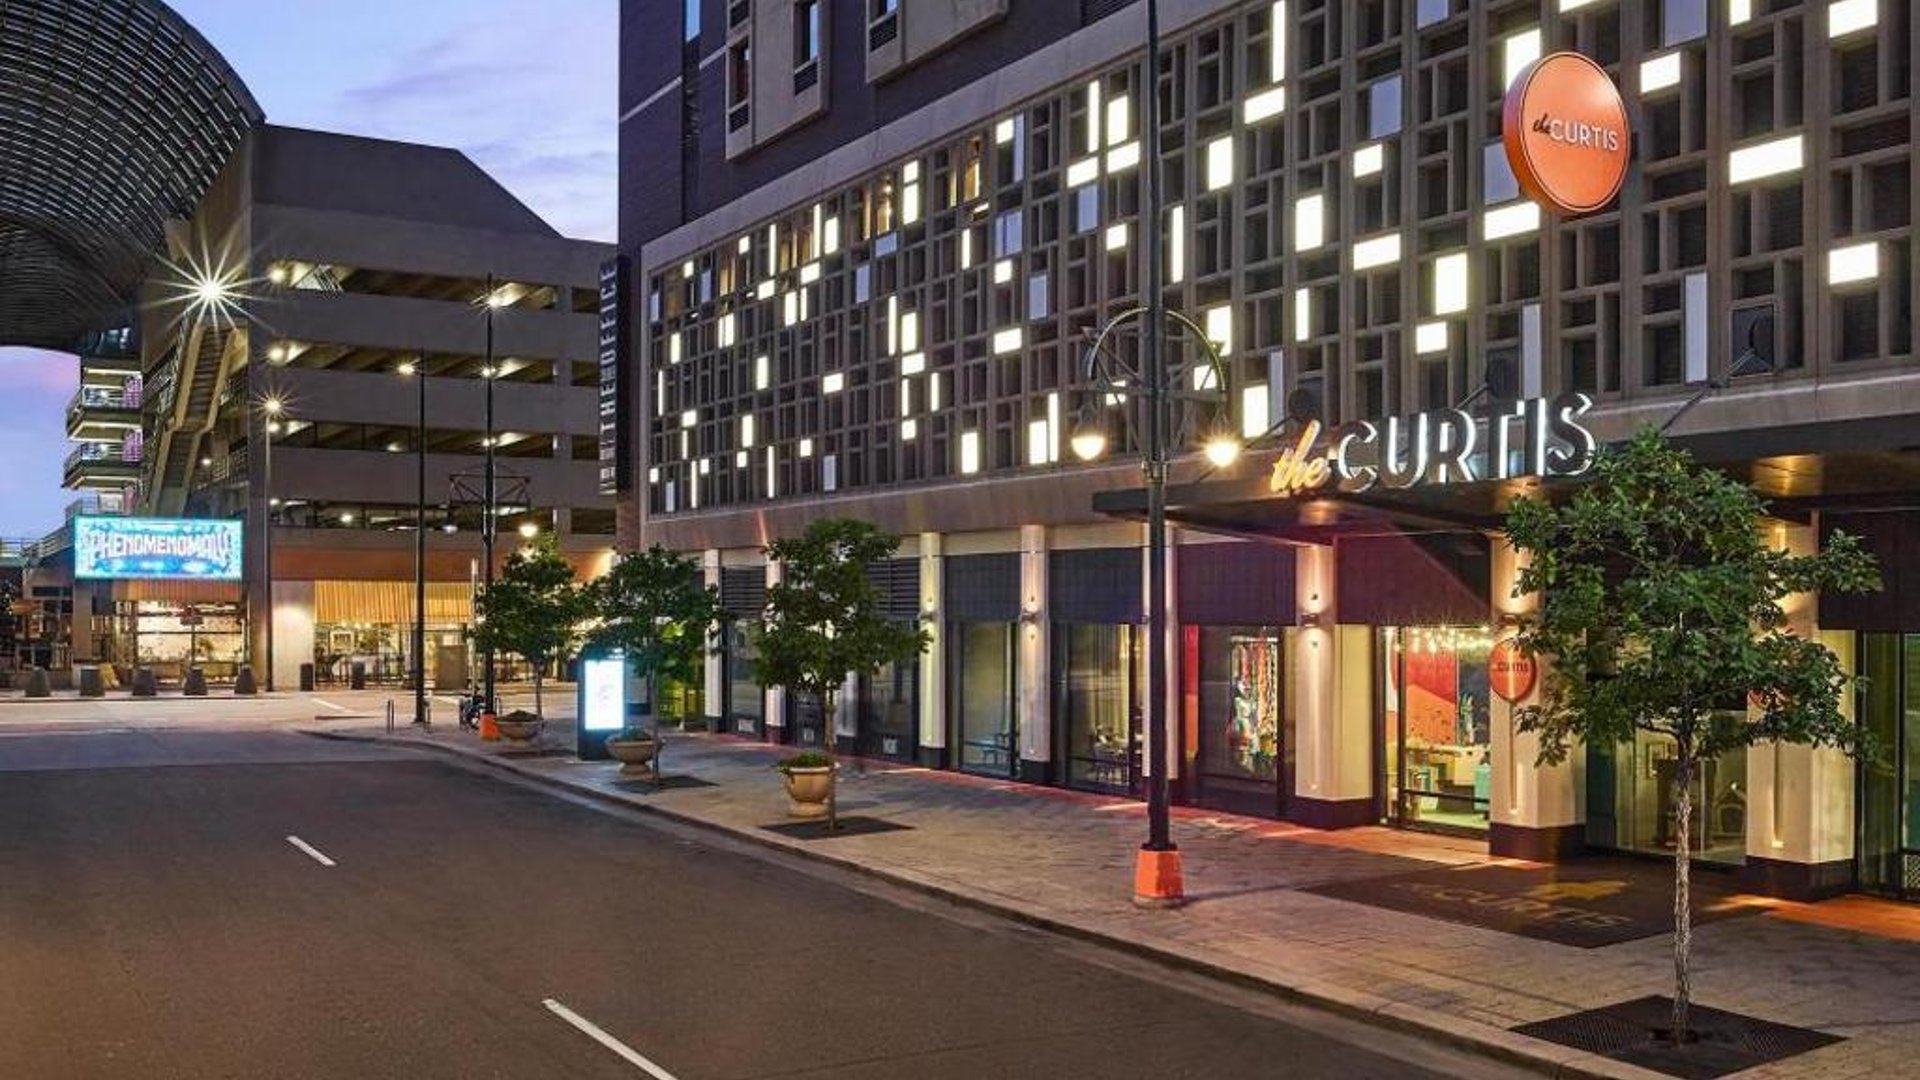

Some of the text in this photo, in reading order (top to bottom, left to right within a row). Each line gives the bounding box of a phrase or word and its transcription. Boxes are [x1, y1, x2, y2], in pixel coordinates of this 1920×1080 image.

[1550, 119, 1619, 151] CURTIS
[600, 265, 618, 365] OFFICE
[1270, 392, 1598, 494] the CURTIS
